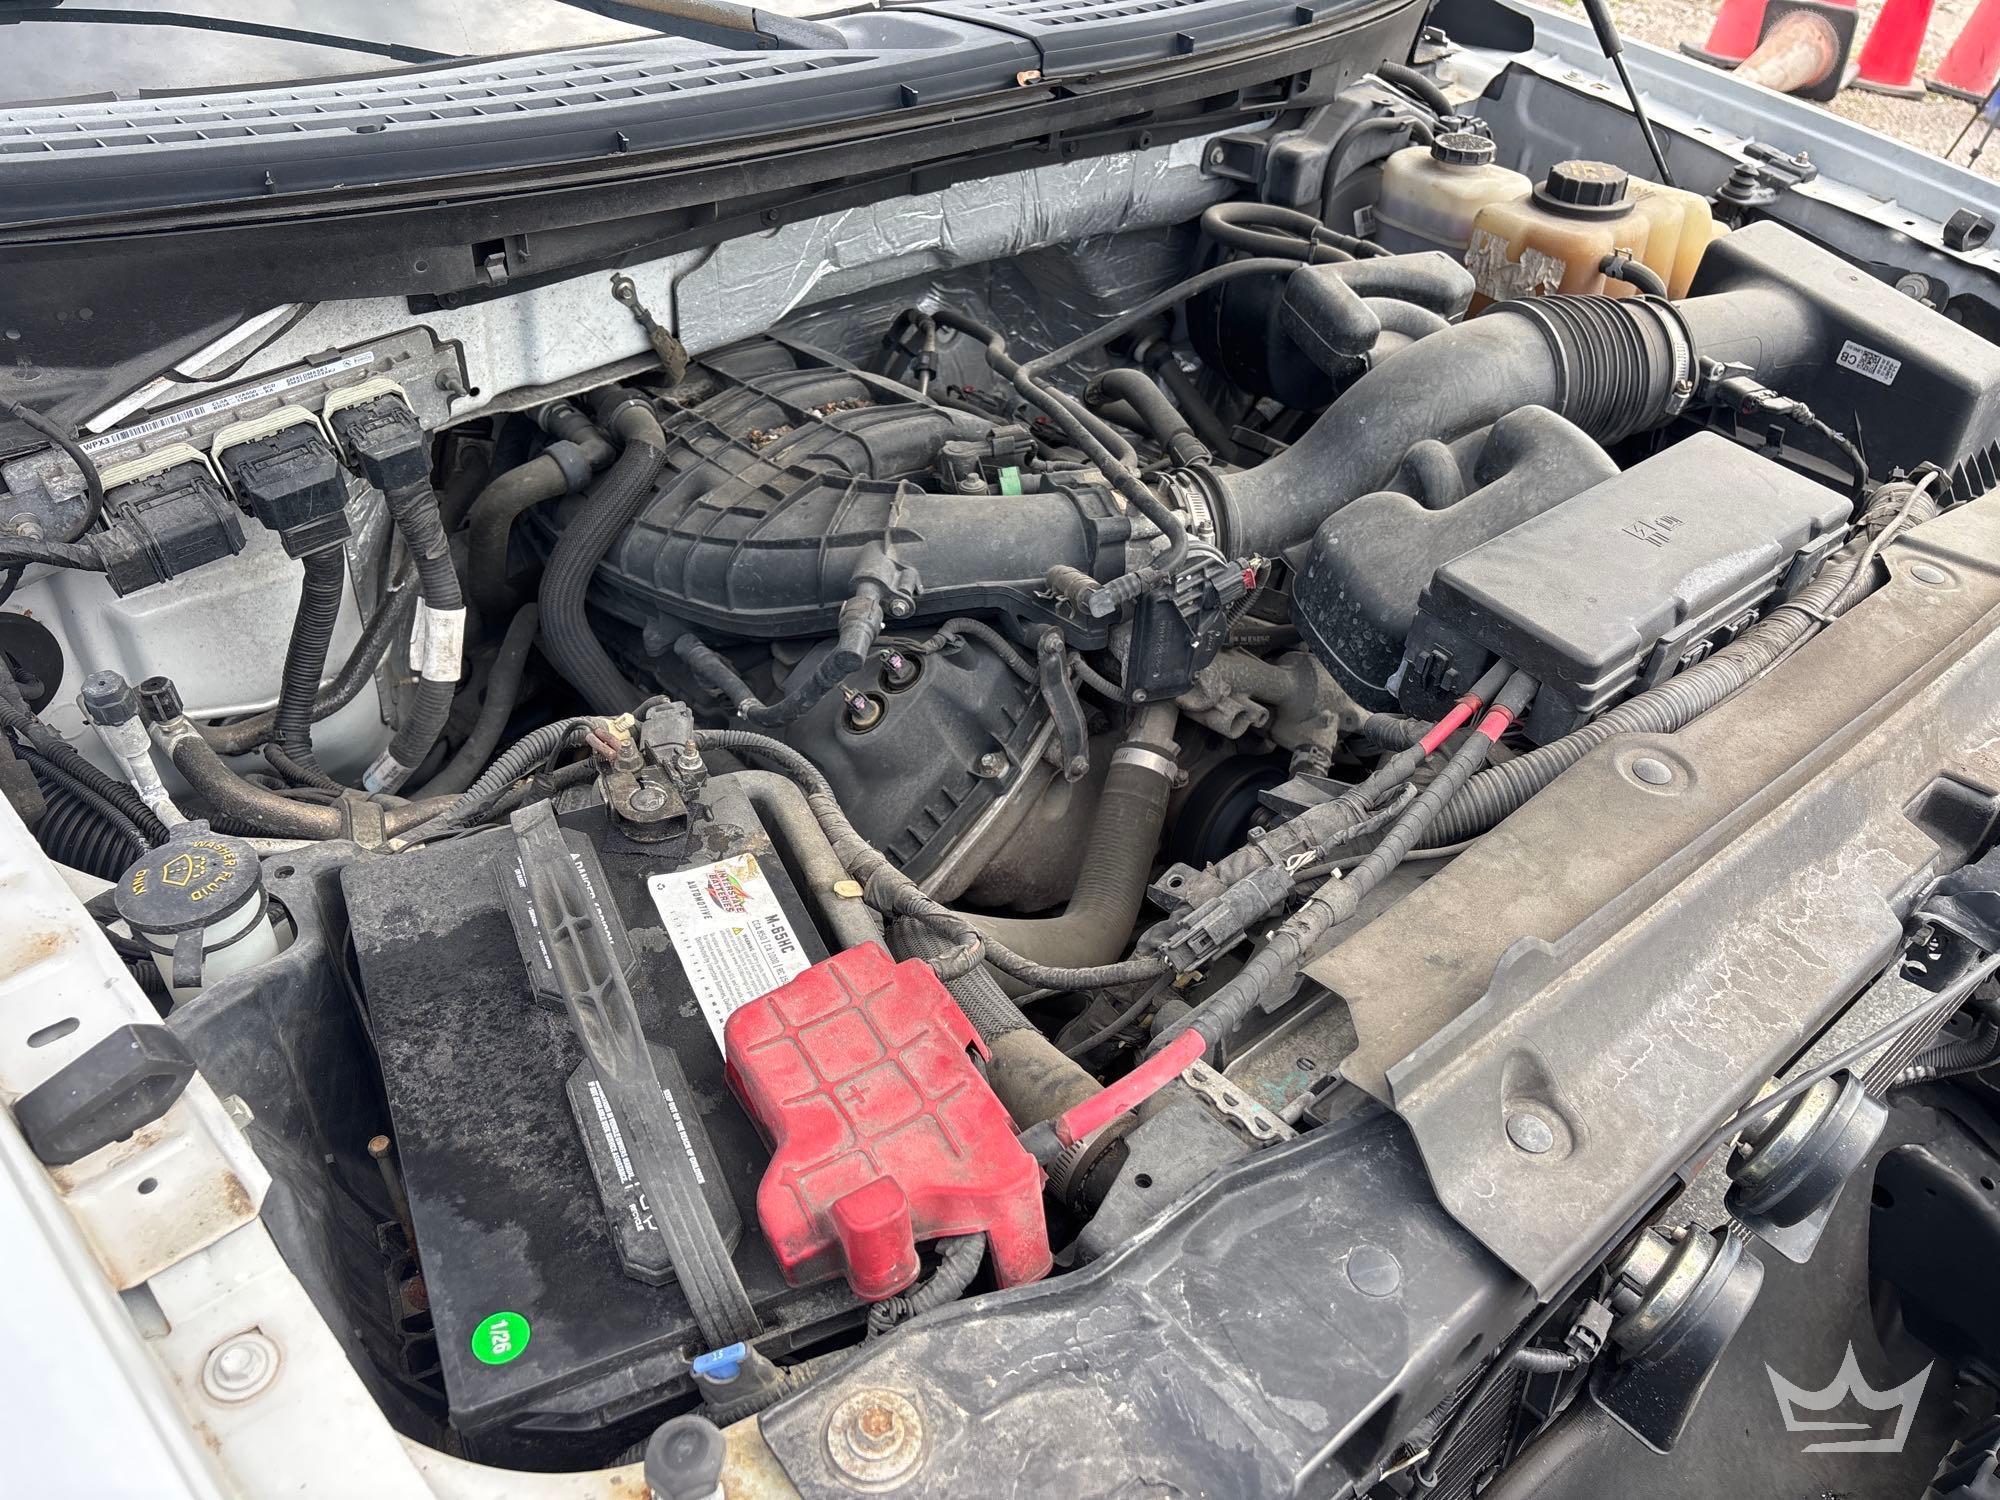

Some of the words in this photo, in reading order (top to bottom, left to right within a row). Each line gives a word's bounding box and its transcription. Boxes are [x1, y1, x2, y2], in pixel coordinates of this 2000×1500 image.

[1840, 352, 1856, 365] CB
[83, 438, 110, 451] WPX3
[192, 840, 237, 866] WASHER
[132, 868, 148, 896] ONLY
[190, 871, 233, 901] FLUID
[708, 874, 734, 912] BATTERIES
[714, 870, 745, 912] INTERSTATE
[686, 880, 712, 920] AUTOMOTIVE
[752, 920, 761, 930] CCA
[764, 944, 772, 952] CA
[764, 914, 795, 954] M-65HC
[629, 1203, 644, 1232] RECYCLE
[490, 1319, 512, 1355] 1/26
